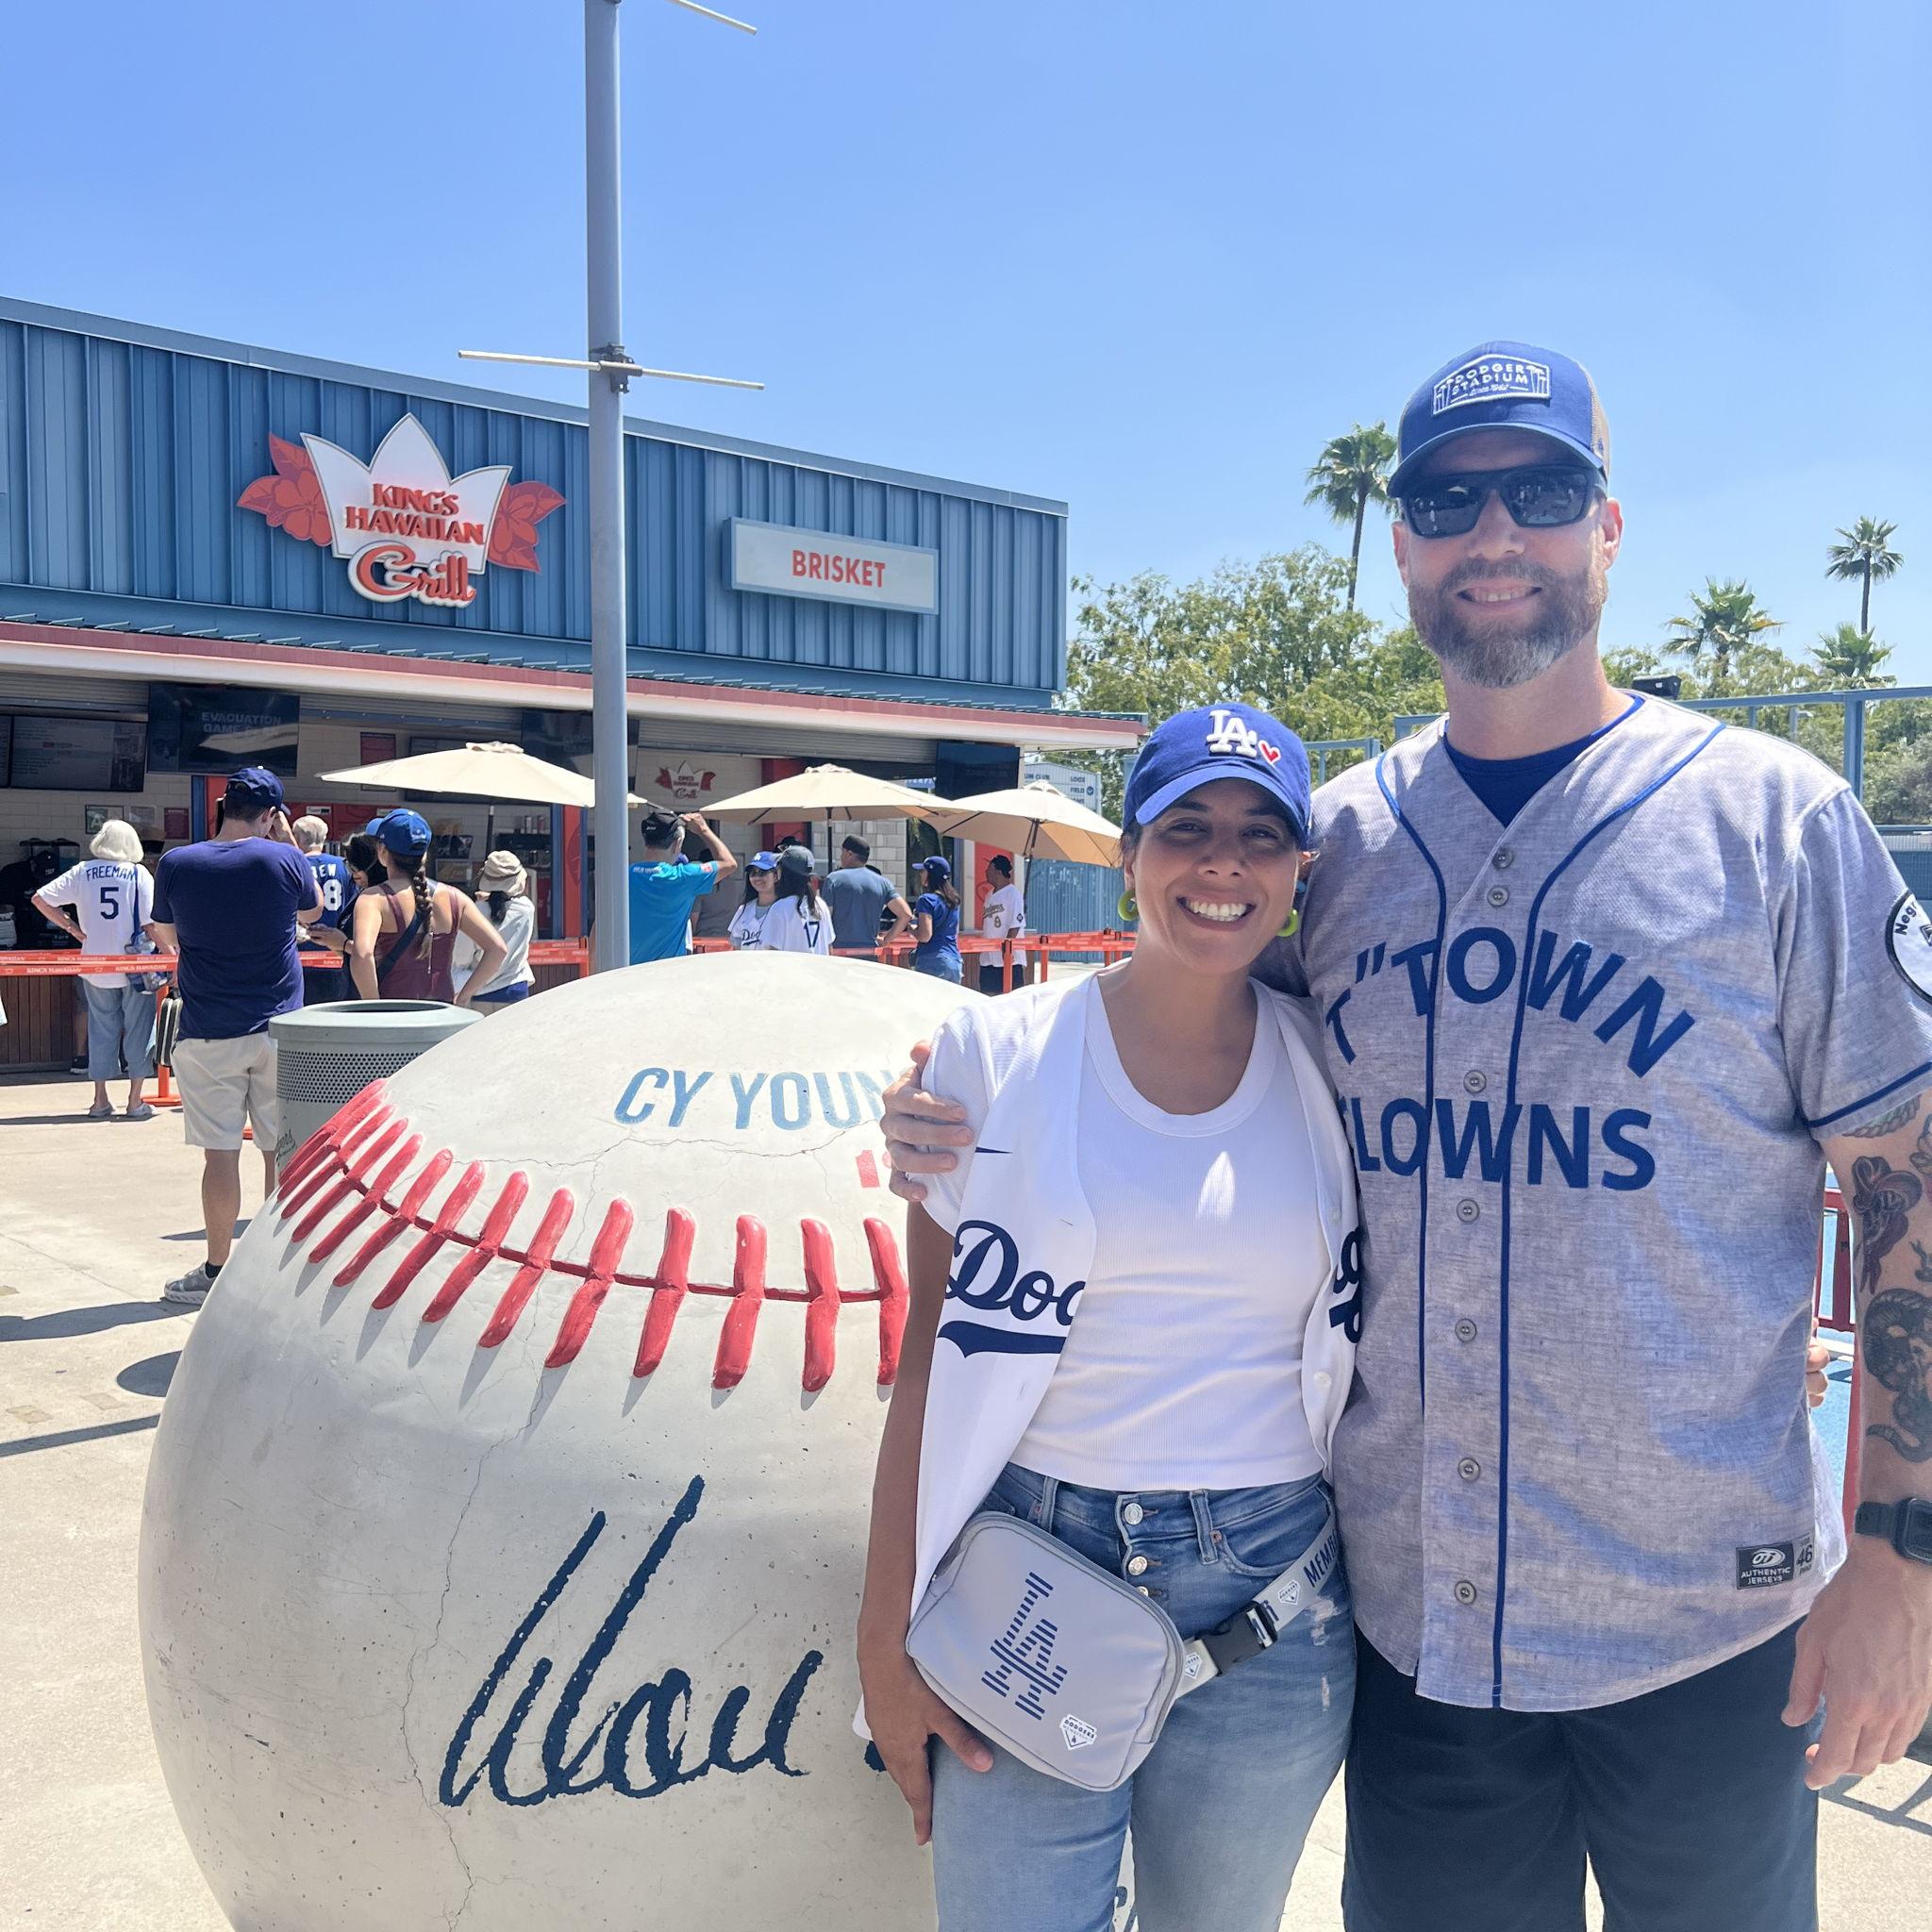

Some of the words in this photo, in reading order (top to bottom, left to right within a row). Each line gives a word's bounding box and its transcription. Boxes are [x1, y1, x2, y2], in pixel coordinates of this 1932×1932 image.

[1451, 373, 1528, 396] STADIUM
[1454, 363, 1524, 384] DODGER
[344, 506, 485, 545] HAWAIIAN
[356, 543, 477, 603] Grill
[792, 549, 887, 589] BRISKET
[201, 711, 282, 725] EVACUATION
[1206, 708, 1257, 758] LA
[86, 865, 135, 882] FREEMAN
[100, 886, 120, 920] 5
[804, 921, 821, 948] 17
[1391, 926, 1696, 1078] TOWN
[613, 1067, 715, 1127] CY
[1339, 1096, 1657, 1191] LOWNS
[1795, 1543, 1813, 1567] 46
[1740, 1566, 1791, 1579] AUTHENTIC
[1747, 1575, 1783, 1586] JERSEYS
